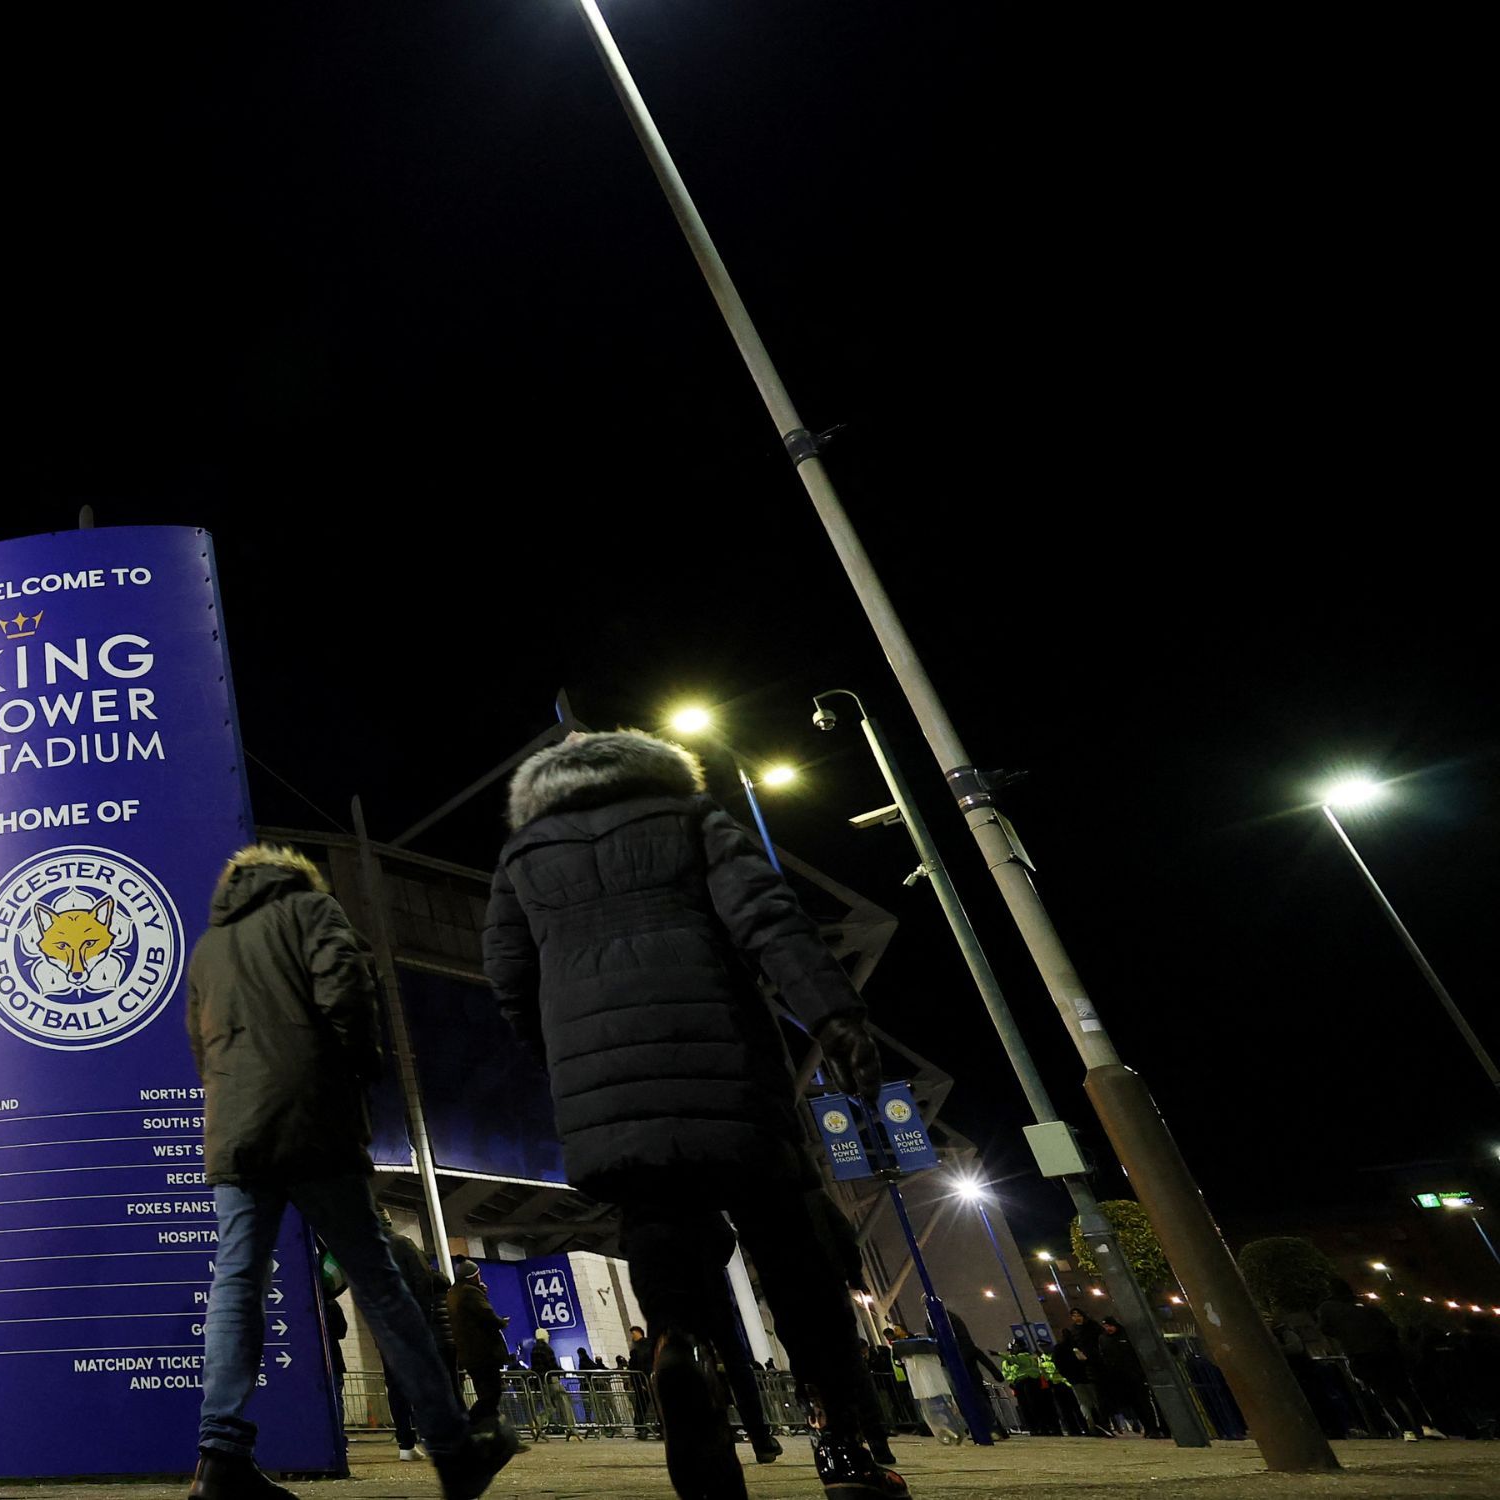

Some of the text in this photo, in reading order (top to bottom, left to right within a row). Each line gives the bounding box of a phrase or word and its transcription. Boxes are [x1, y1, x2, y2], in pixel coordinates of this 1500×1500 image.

[111, 567, 152, 585] TO
[97, 799, 140, 822] OF
[118, 878, 164, 931] CITY
[117, 946, 166, 1013] CLUB
[140, 1088, 187, 1100] NORTH
[143, 1117, 190, 1129] SOUTH
[894, 1130, 922, 1142] KING
[831, 1141, 858, 1152] KING
[897, 1138, 925, 1148] POWER
[153, 1145, 192, 1157] WEST
[833, 1149, 859, 1157] POWER
[900, 1145, 928, 1154] STADIUM
[835, 1155, 862, 1163] STADIUM
[127, 1202, 172, 1215] FOXES
[534, 1276, 564, 1298] 44
[541, 1301, 570, 1324] 46
[74, 1357, 154, 1372] MATCHDAY
[129, 1376, 161, 1390] AND
